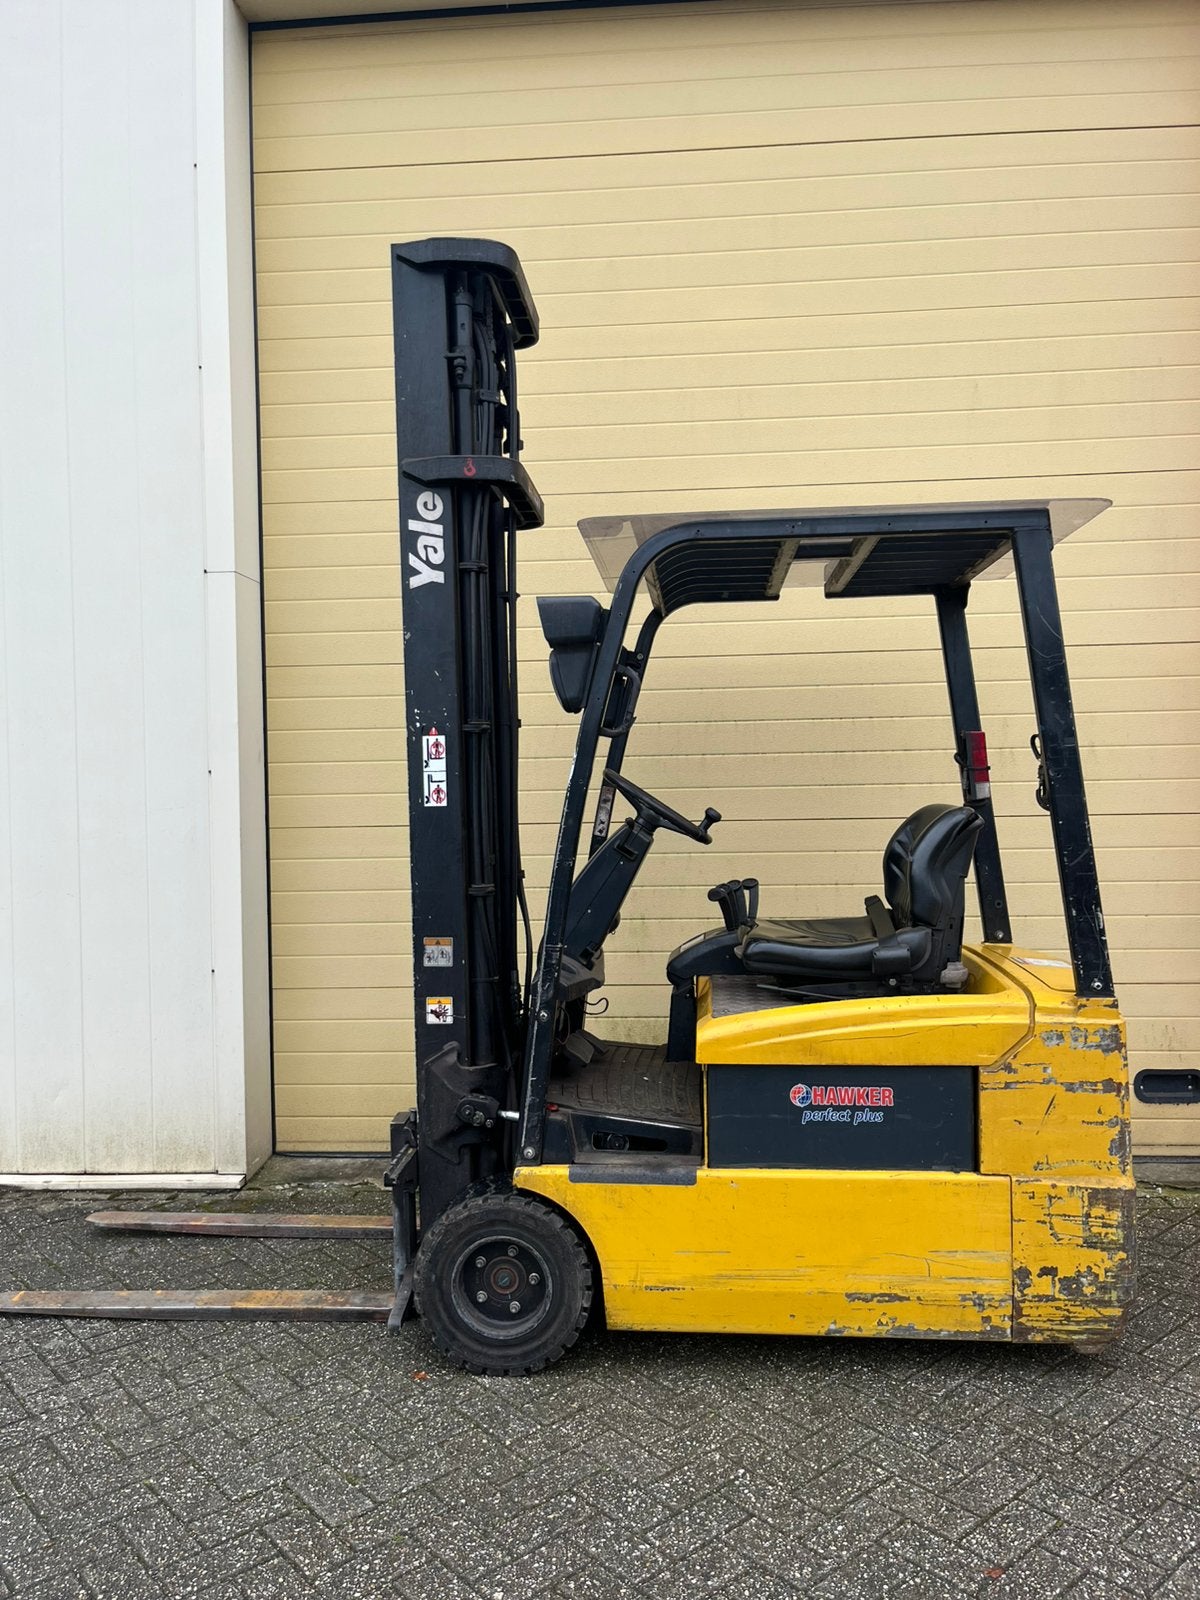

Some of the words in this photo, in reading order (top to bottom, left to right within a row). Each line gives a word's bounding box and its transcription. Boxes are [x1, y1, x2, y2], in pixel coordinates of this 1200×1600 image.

[408, 491, 445, 589] Yale
[811, 1086, 894, 1106] HAWKER
[802, 1107, 851, 1125] perfect
[853, 1108, 884, 1125] plus
